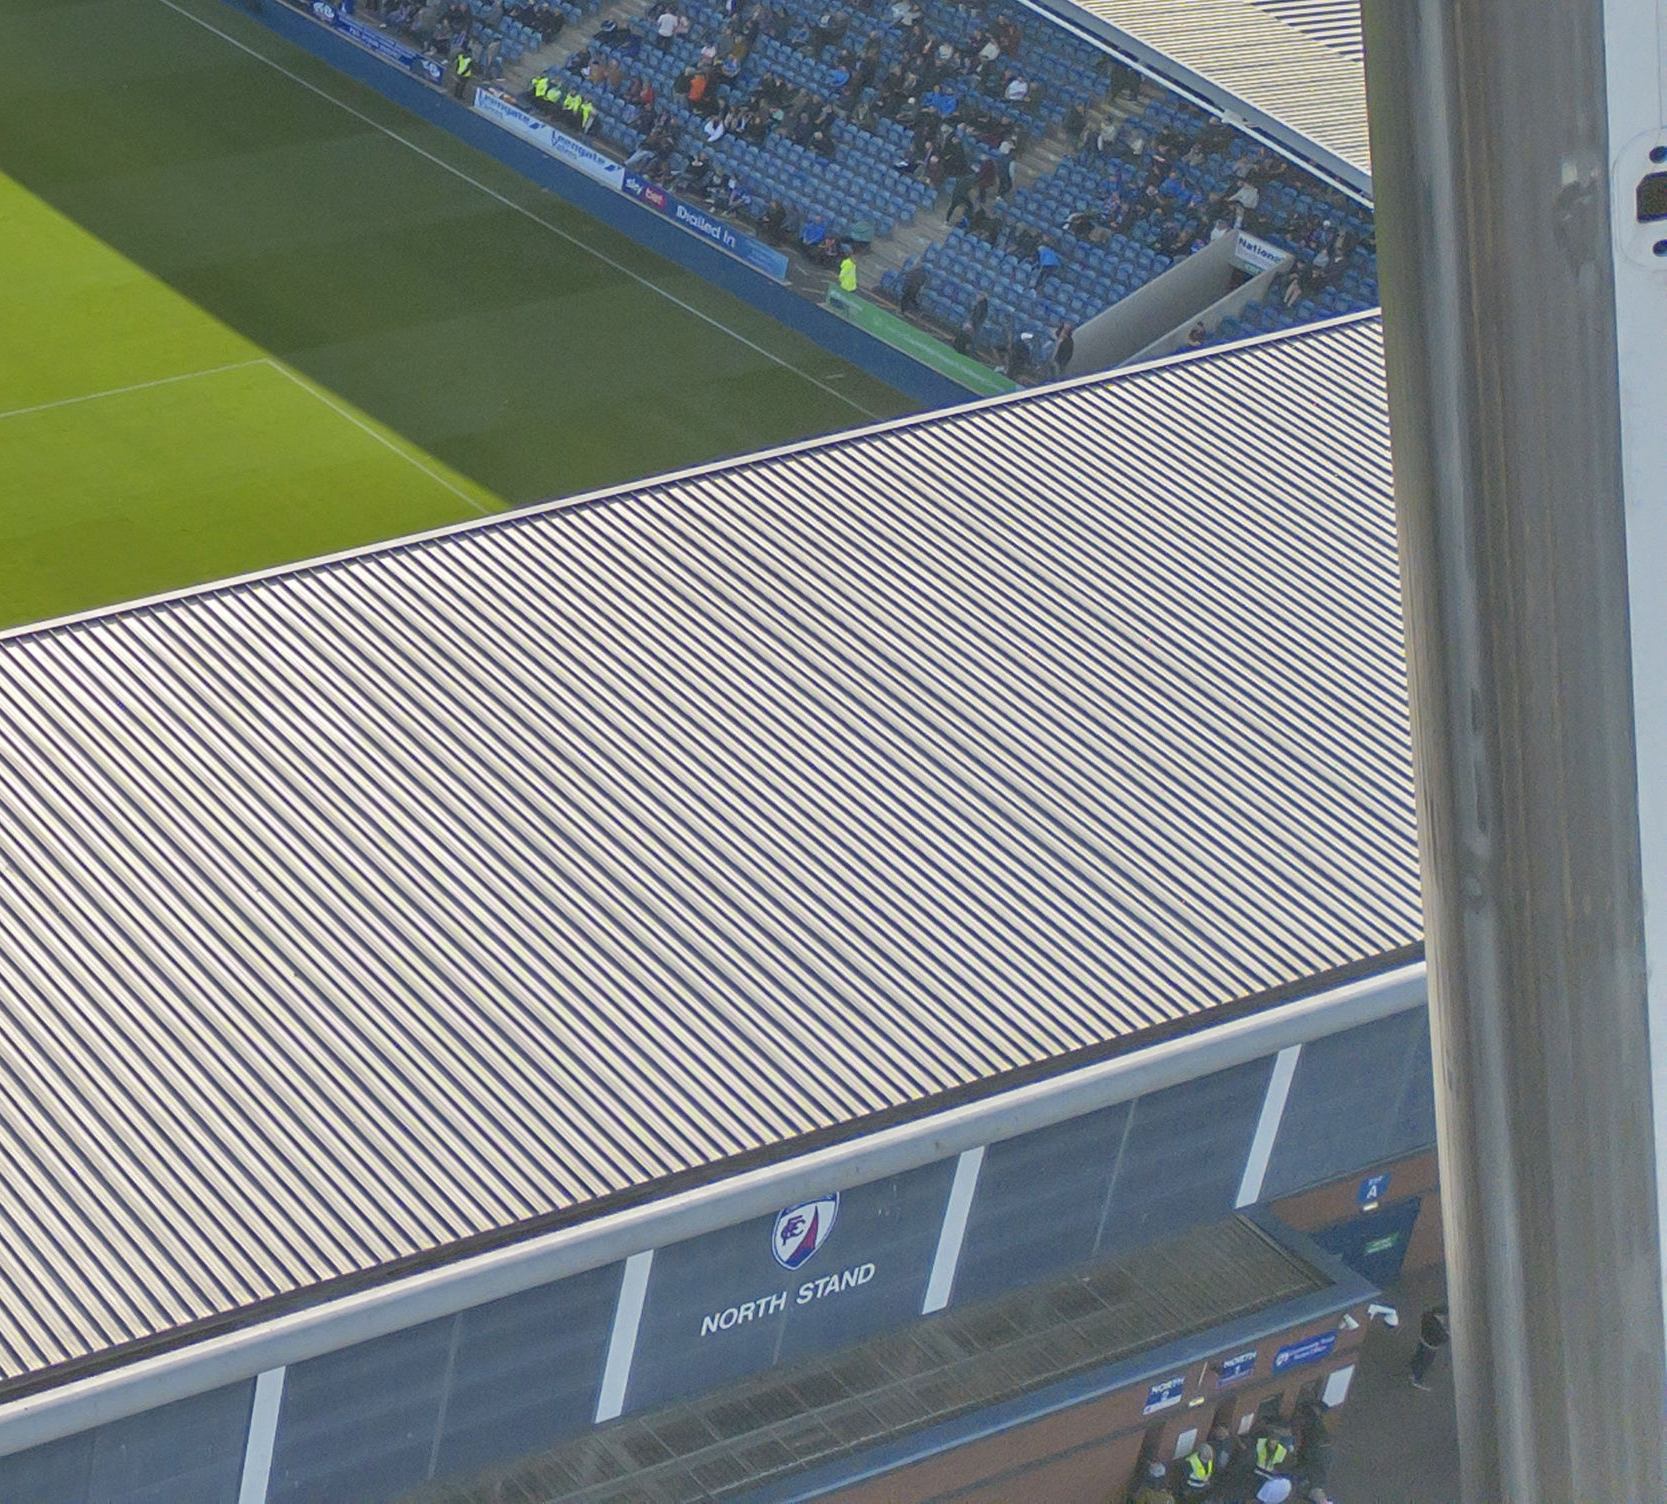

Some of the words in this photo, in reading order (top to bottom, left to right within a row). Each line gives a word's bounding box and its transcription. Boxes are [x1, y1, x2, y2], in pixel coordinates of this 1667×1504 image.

[625, 178, 643, 195] sky
[644, 186, 664, 206] bet
[1366, 1184, 1378, 1199] A
[700, 1291, 788, 1337] NORTH
[796, 1262, 876, 1305] STAND
[1223, 1351, 1257, 1369] NORTH
[1151, 1376, 1186, 1394] NORTH
